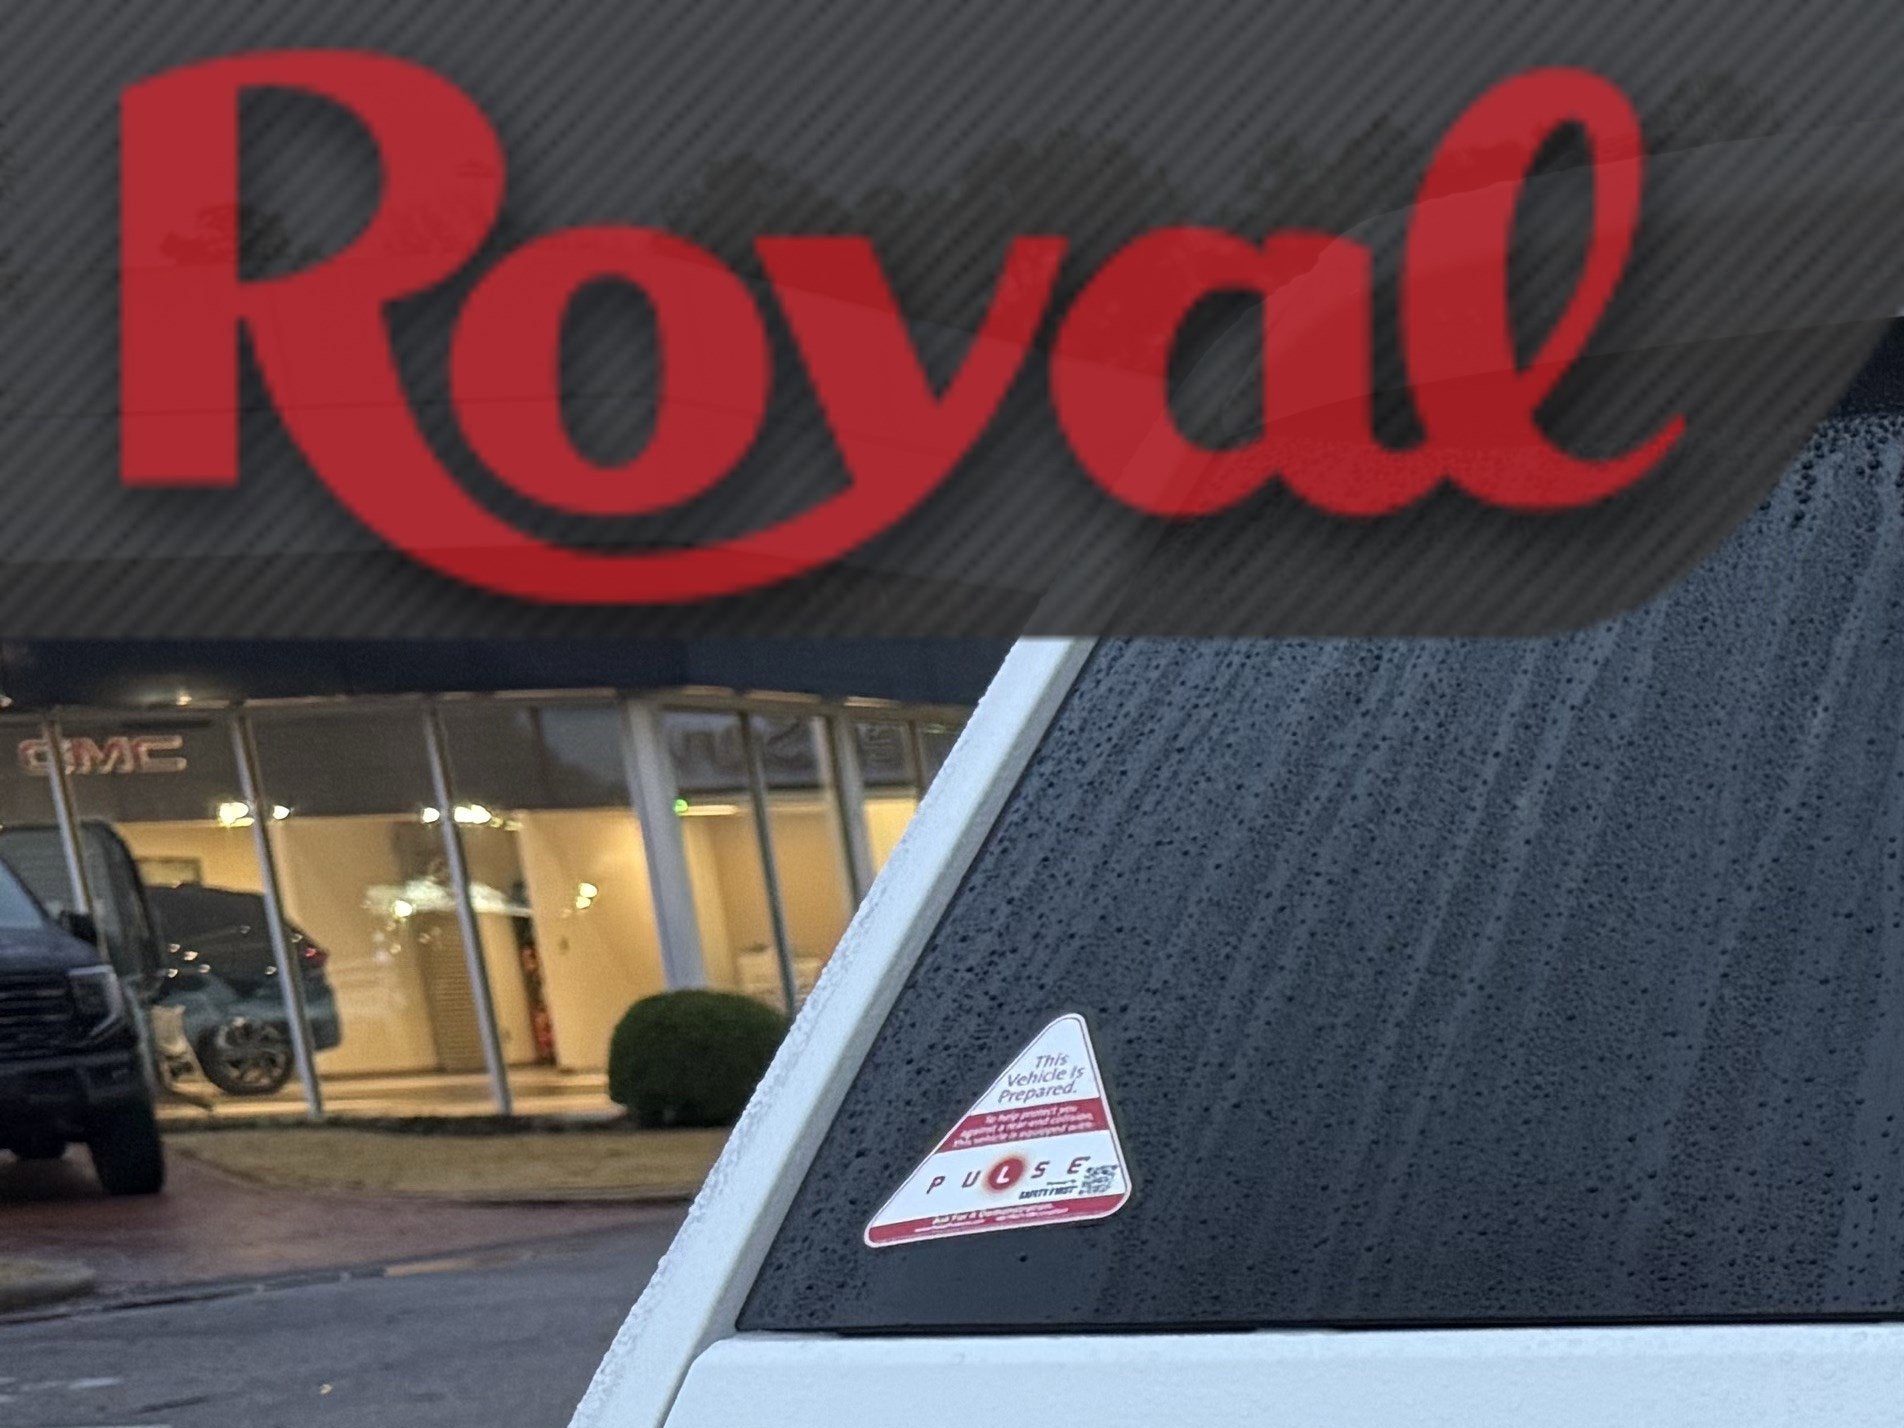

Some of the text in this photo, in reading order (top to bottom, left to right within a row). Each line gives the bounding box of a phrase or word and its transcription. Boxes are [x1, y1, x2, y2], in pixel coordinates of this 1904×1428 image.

[17, 734, 188, 776] GMC
[1036, 1053, 1069, 1069] This
[1008, 1065, 1085, 1087] Vehicle Is
[998, 1080, 1077, 1103] Prepared.
[926, 1156, 1091, 1195] PULSE
